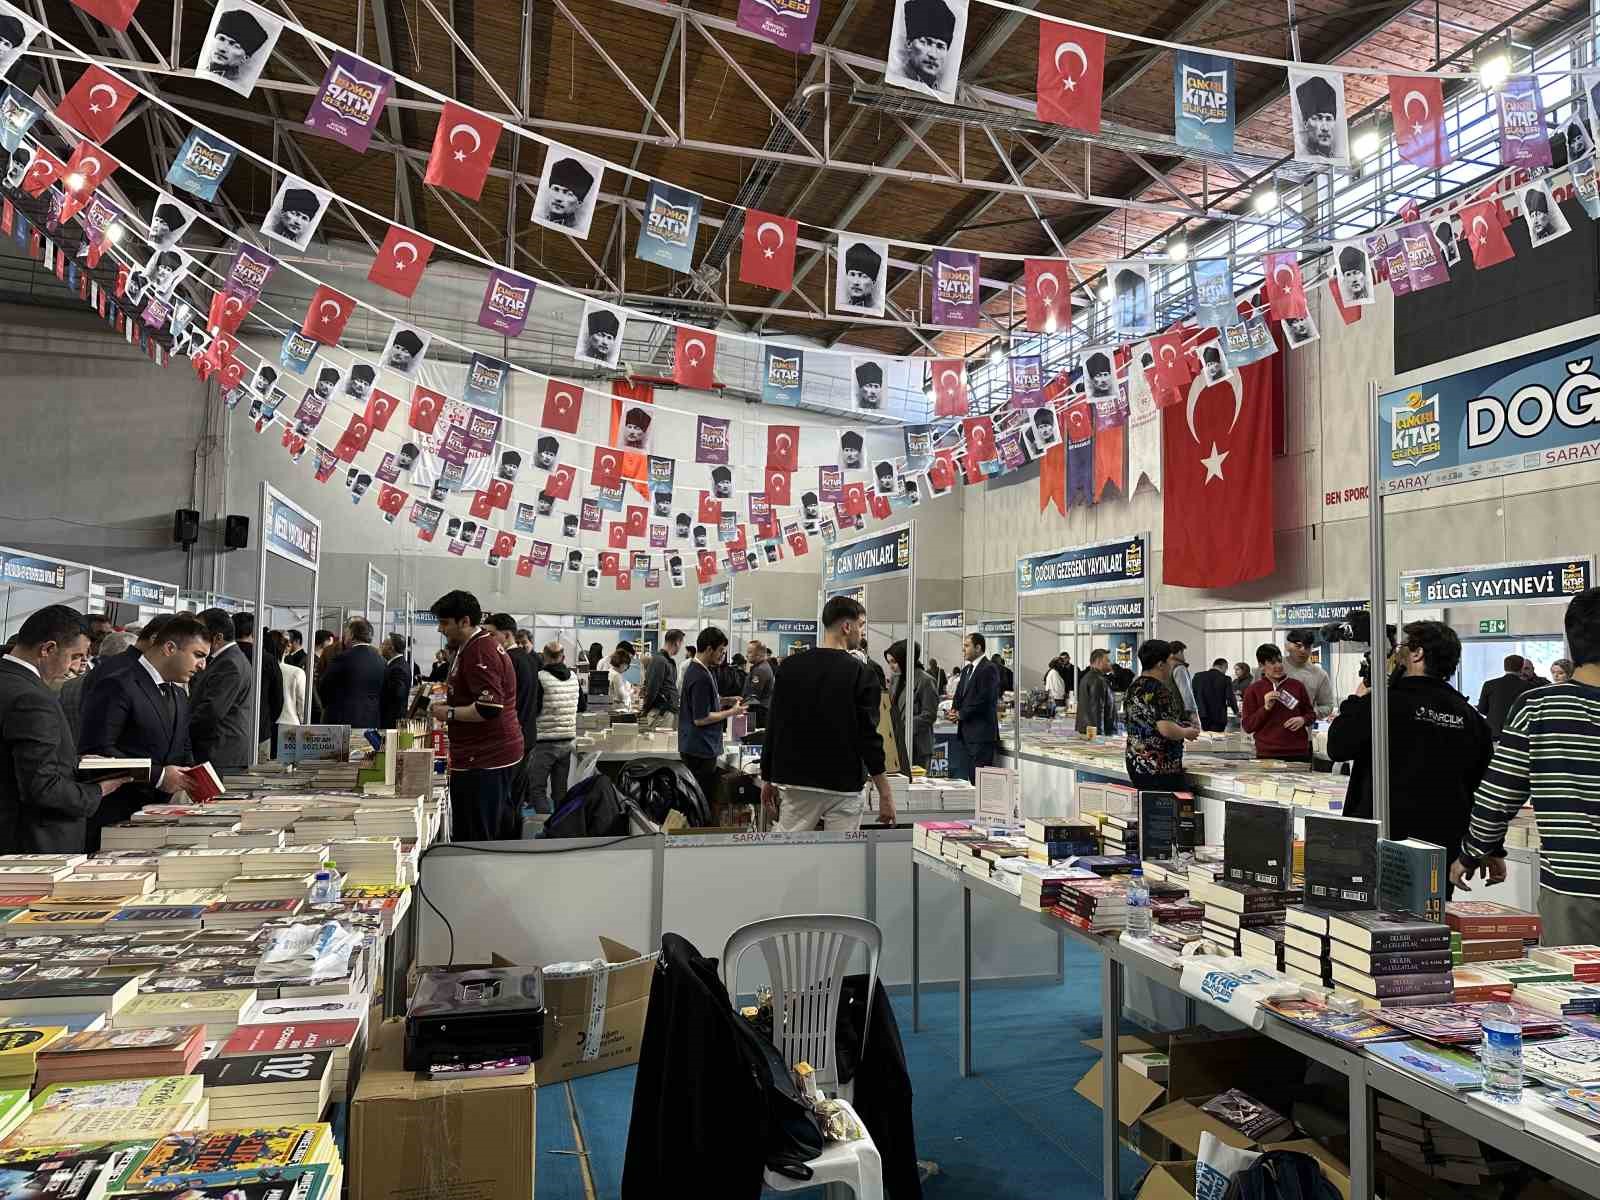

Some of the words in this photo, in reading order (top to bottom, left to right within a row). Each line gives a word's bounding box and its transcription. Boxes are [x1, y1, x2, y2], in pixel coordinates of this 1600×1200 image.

[1183, 88, 1227, 109] KİTAP
[491, 293, 526, 311] KİTAP
[768, 369, 800, 380] KİTAP
[1015, 374, 1040, 385] KİTAP
[1466, 357, 1600, 450] DOĞ
[1391, 422, 1440, 451] KİTAP
[1545, 443, 1600, 465] SARAY
[1388, 475, 1430, 492] SARAY
[1325, 491, 1342, 505] BEN
[1344, 486, 1369, 502] SPORC
[837, 555, 853, 574] CAN
[854, 543, 894, 570] YAYINLARI
[1057, 556, 1087, 580] GEZEGENİ
[1087, 552, 1122, 576] YAYINLARI
[1427, 578, 1468, 600] BİLGİ
[1472, 570, 1555, 597] YAYINEVİ
[1088, 606, 1107, 618] TİMAŞ
[1108, 603, 1141, 615] YAYINLARI
[611, 617, 643, 626] YAYINLA
[793, 622, 815, 631] KİTAP
[732, 832, 767, 843] SARAY
[259, 1053, 317, 1079] 112
